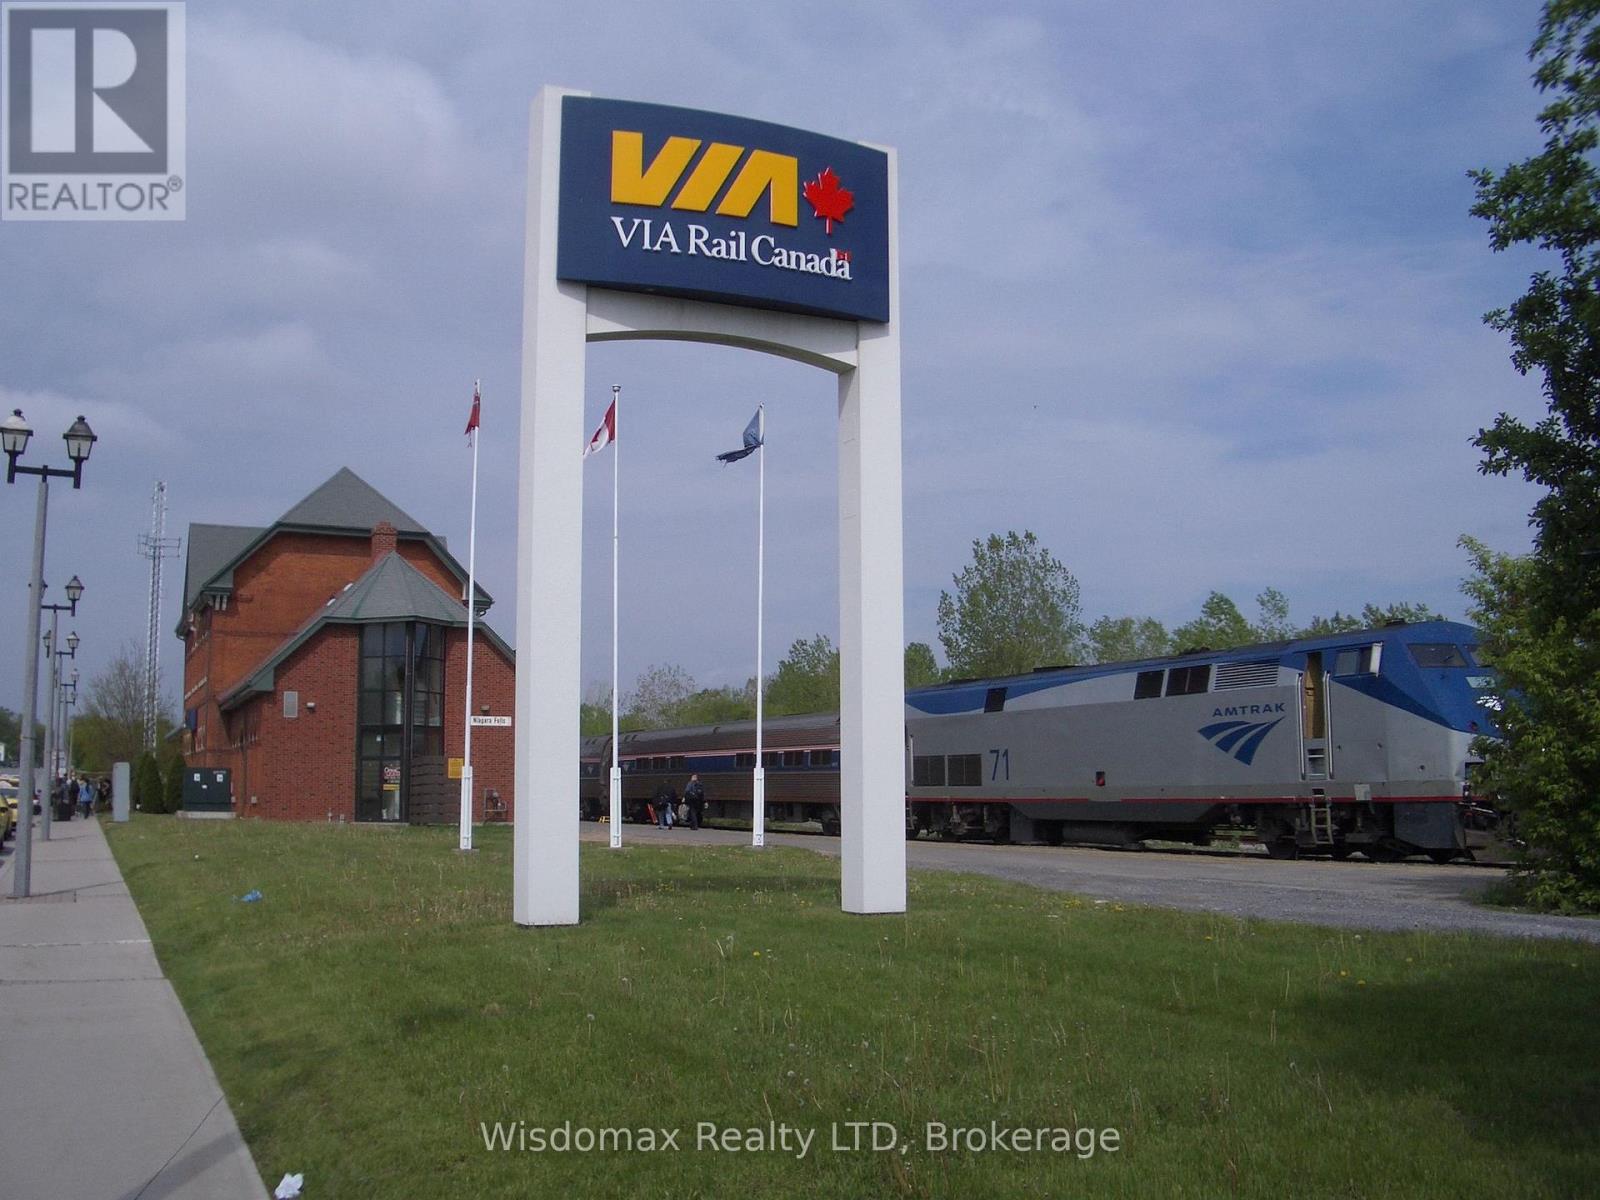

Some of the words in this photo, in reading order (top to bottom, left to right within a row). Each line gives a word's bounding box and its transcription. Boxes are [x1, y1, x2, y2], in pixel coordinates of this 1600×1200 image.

[611, 130, 799, 227] VIA
[610, 215, 682, 254] VIA
[687, 223, 748, 262] Rail
[750, 234, 853, 281] Canada
[1212, 702, 1286, 717] AMTRAK
[989, 748, 1010, 782] 71
